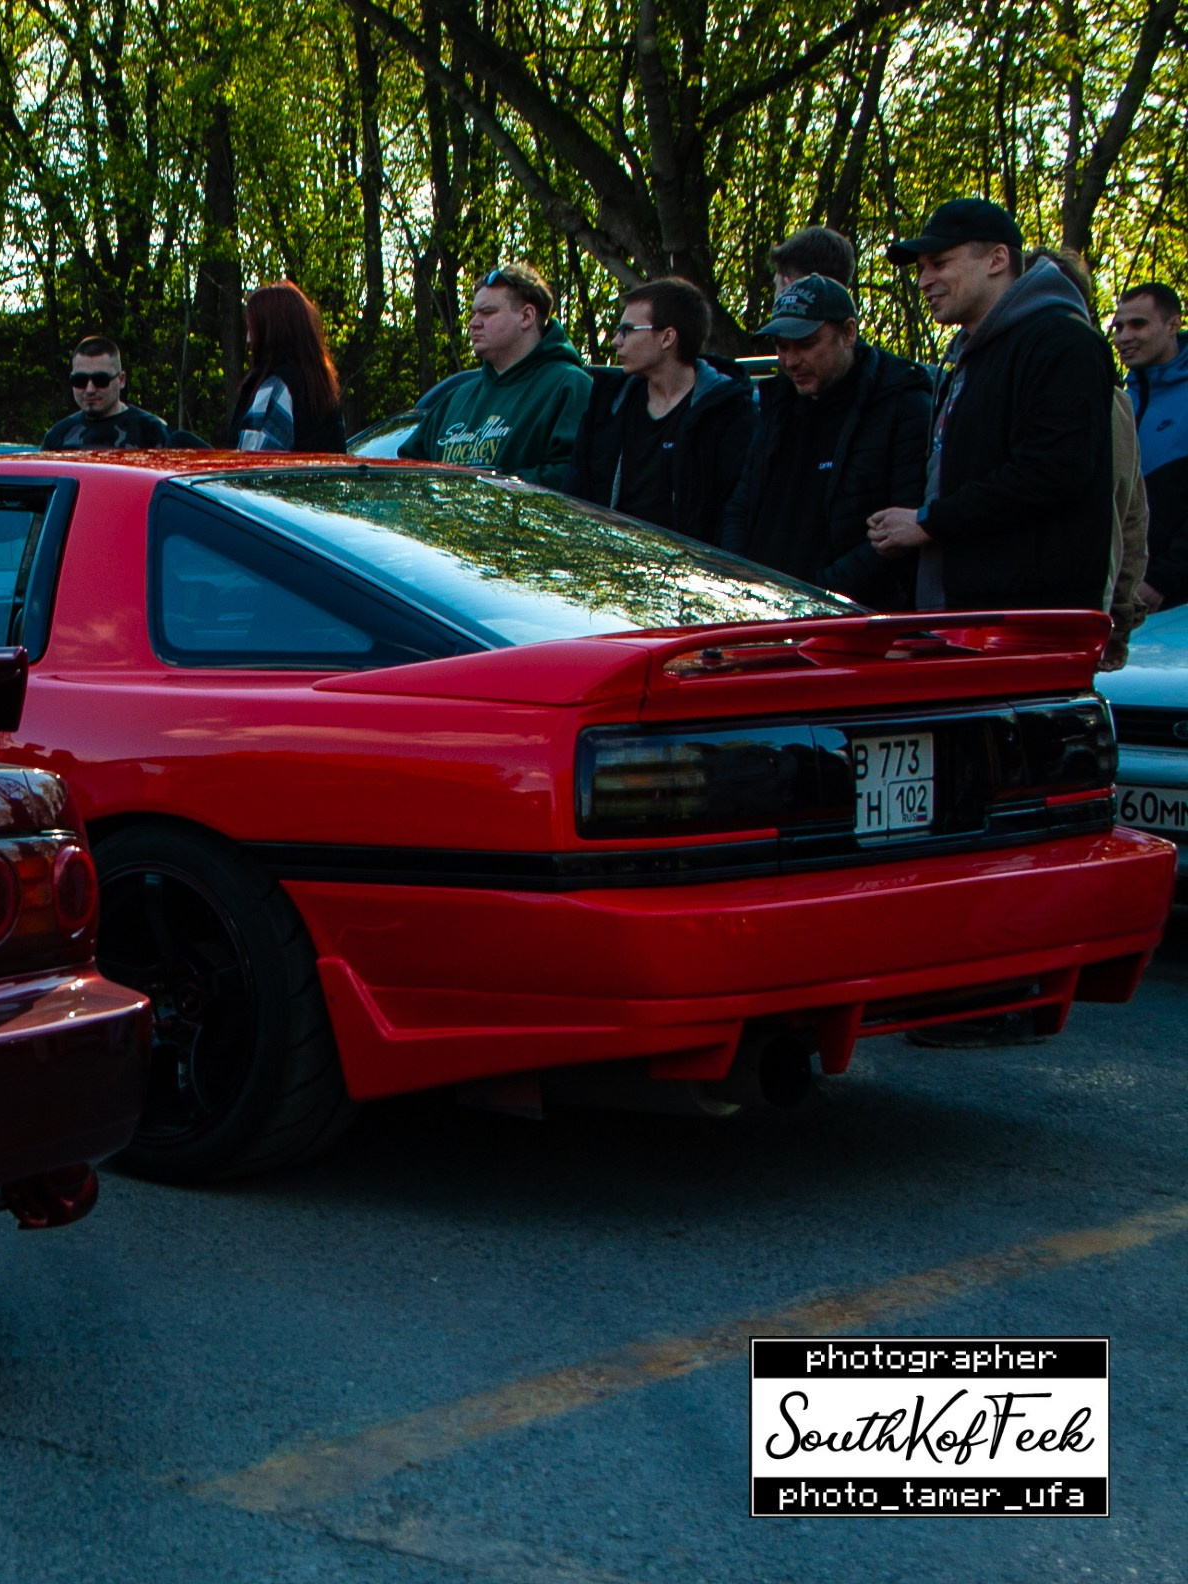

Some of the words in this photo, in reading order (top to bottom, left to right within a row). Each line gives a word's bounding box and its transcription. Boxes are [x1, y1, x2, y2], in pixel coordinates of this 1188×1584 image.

[441, 437, 501, 464] Hockey
[879, 739, 920, 778] 773
[895, 784, 927, 814] 102
[902, 812, 917, 823] RUS
